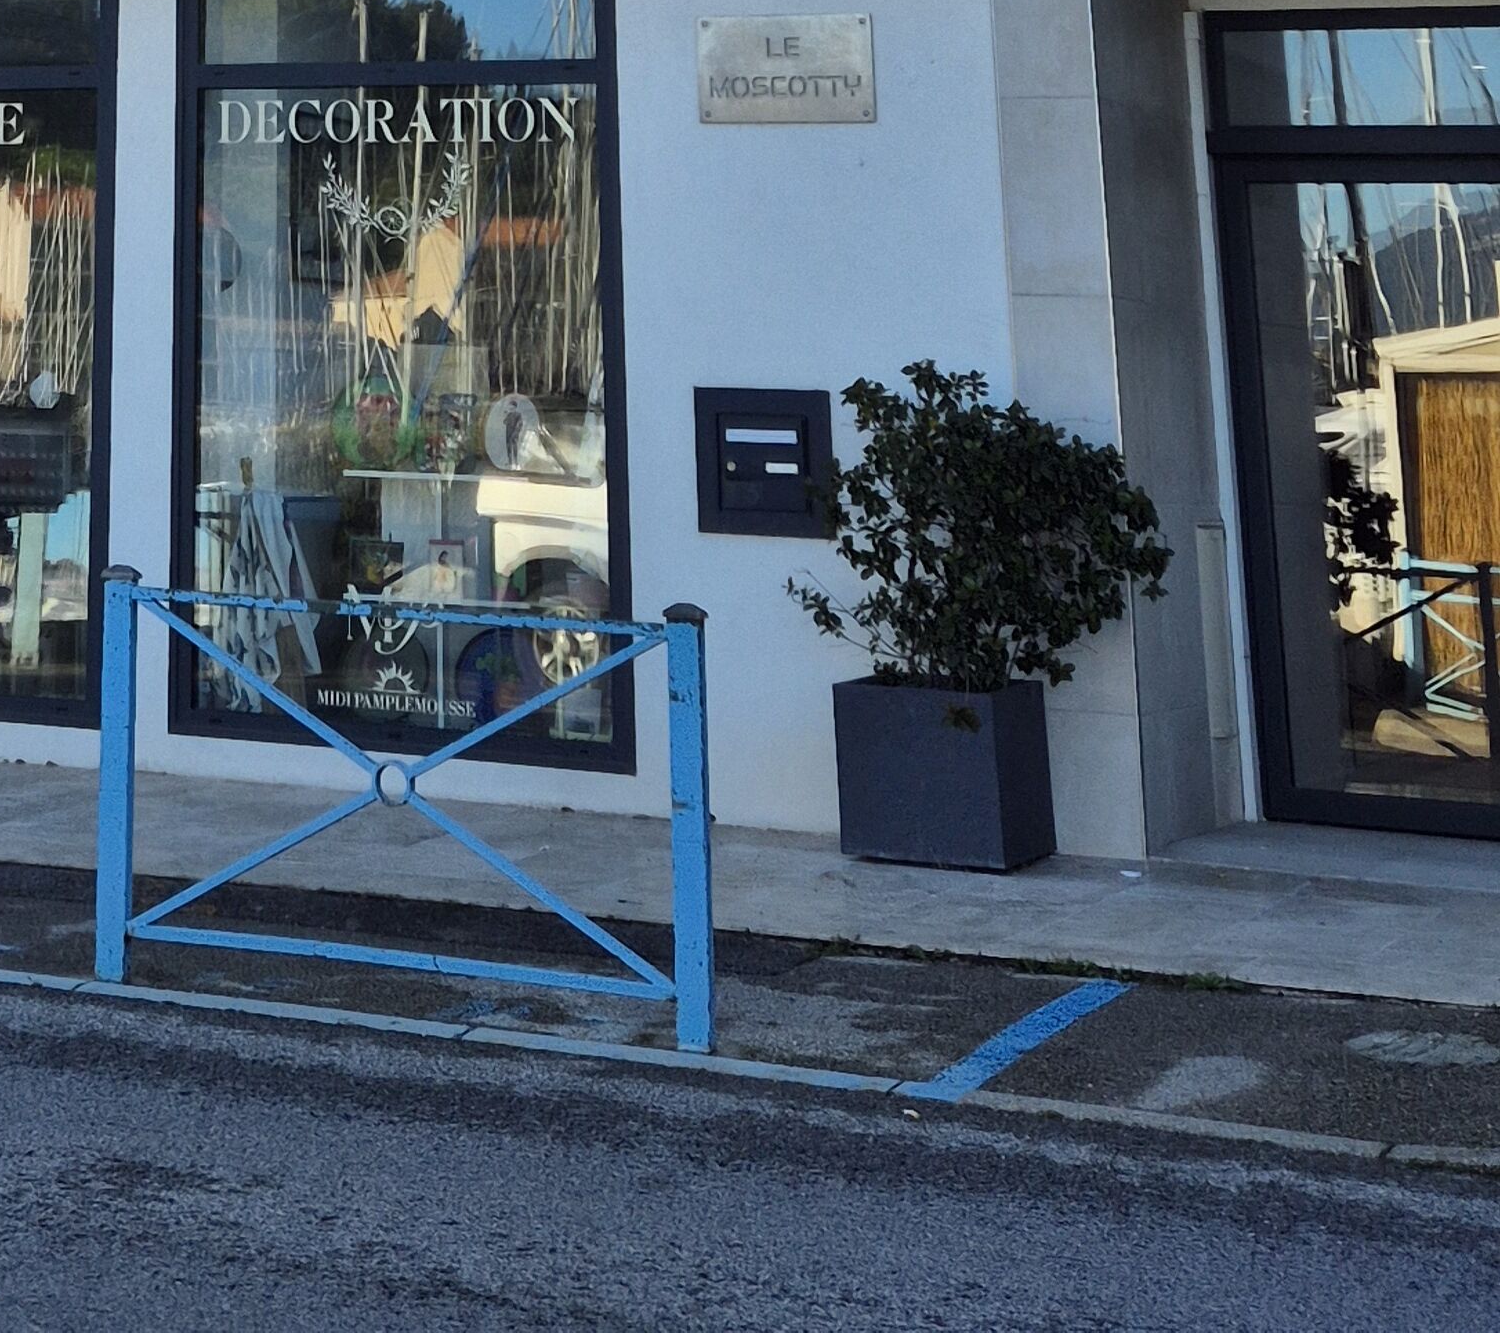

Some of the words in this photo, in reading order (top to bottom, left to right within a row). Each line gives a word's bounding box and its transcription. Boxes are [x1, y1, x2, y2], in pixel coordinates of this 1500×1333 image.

[765, 36, 800, 59] LE
[708, 74, 862, 99] MOSCOTTY
[217, 96, 581, 145] DECORATION
[317, 688, 351, 707] MIDI
